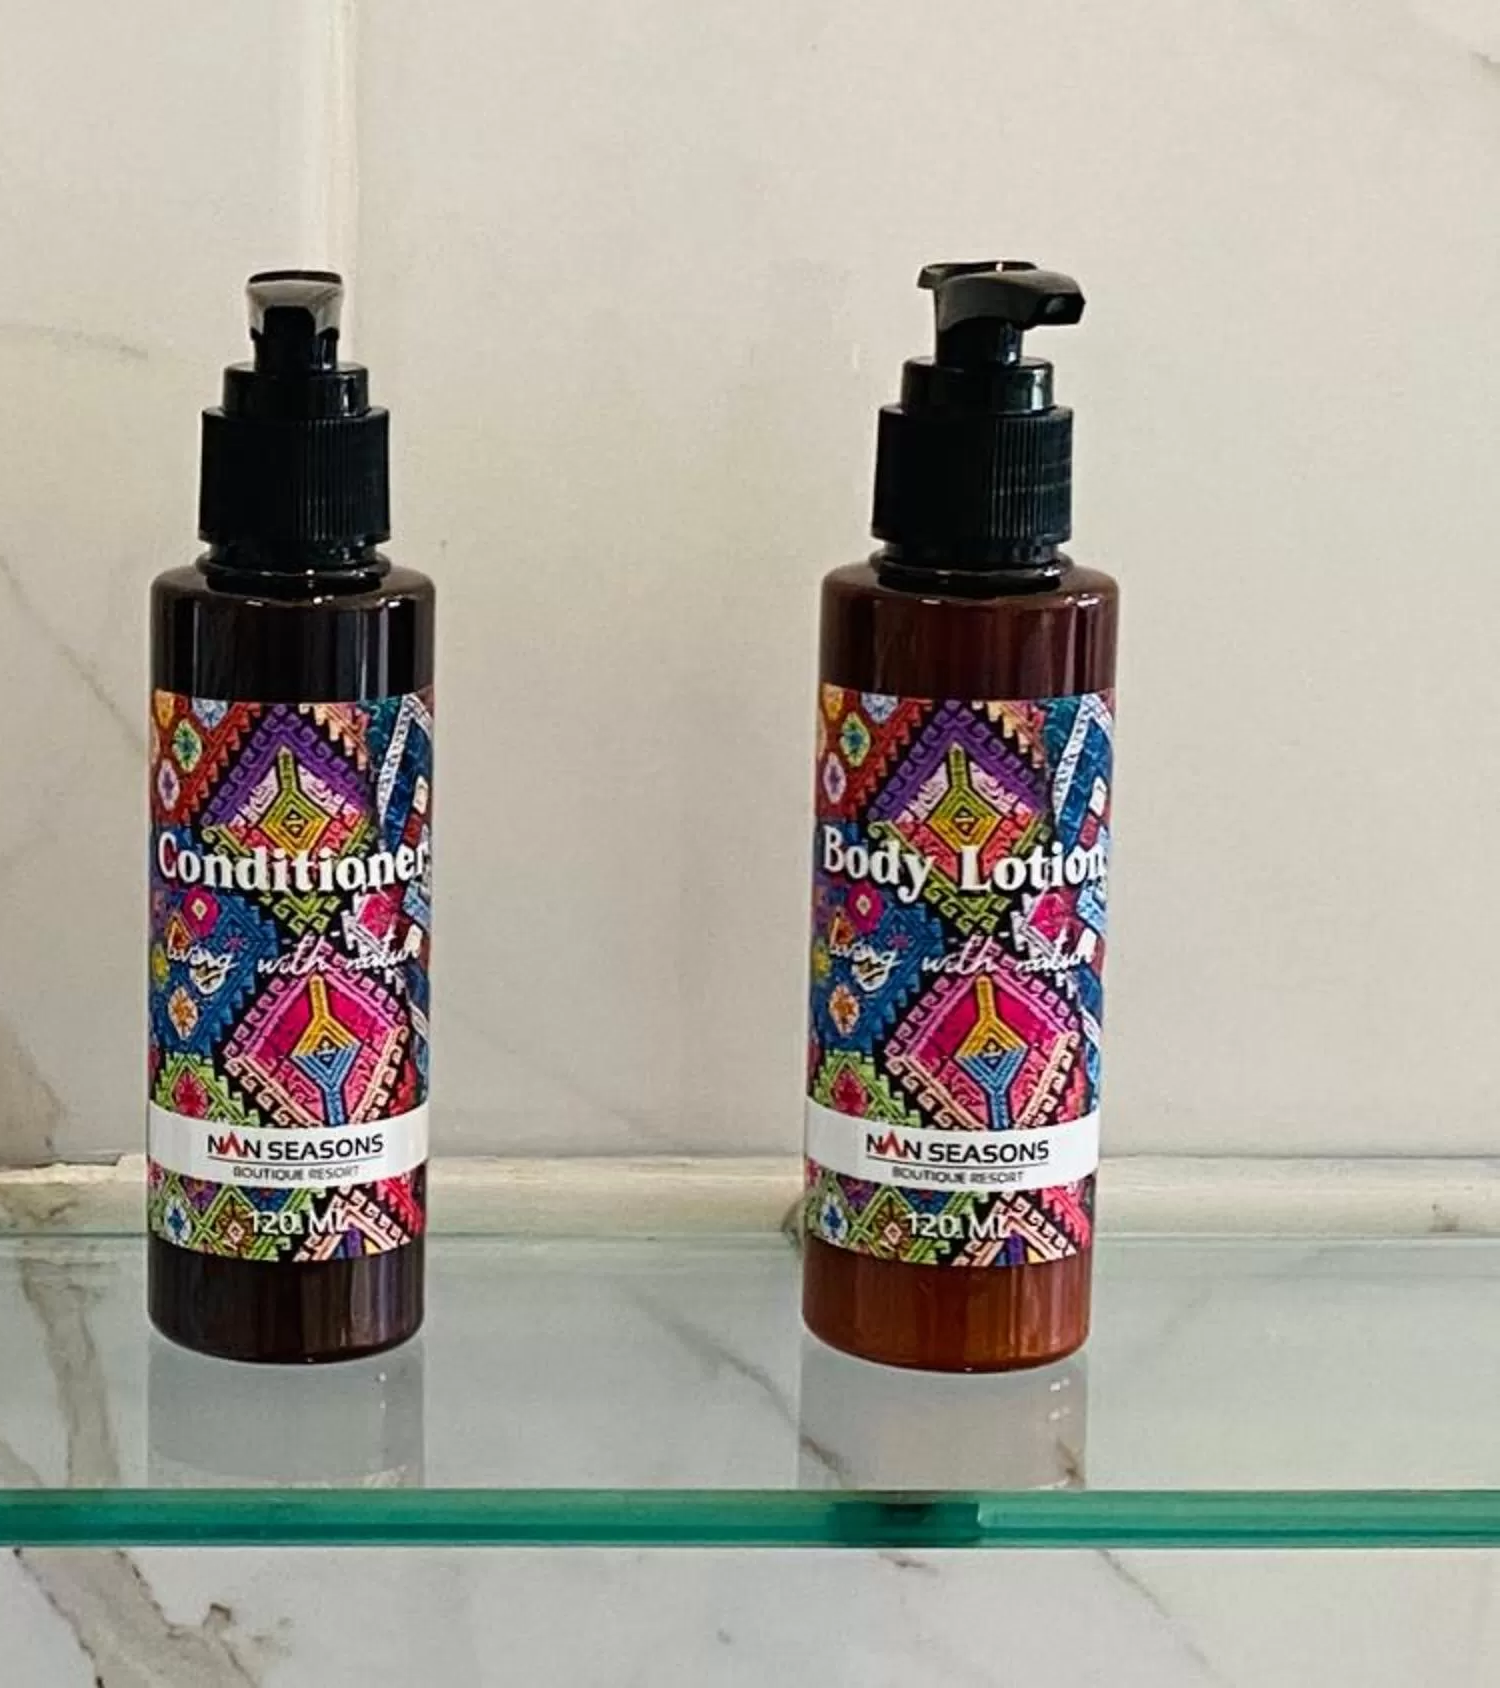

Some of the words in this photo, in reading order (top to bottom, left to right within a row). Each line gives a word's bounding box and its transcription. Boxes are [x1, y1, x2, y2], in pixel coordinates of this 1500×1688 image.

[158, 831, 429, 891] Conditioner
[822, 824, 936, 903] Body
[960, 841, 1108, 892] Lotion
[257, 931, 328, 977] with
[922, 931, 996, 975] with
[207, 1131, 261, 1160] NAN
[267, 1133, 384, 1160] SEASONS
[866, 1130, 921, 1160] NAN
[928, 1139, 1049, 1163] SEASONS
[233, 1165, 304, 1181] BOUTIQUE
[308, 1165, 358, 1180] RESORT
[892, 1167, 966, 1185] BOUTIQUE
[970, 1171, 1024, 1185] RESORT
[251, 1210, 295, 1235] 120
[910, 1213, 956, 1240] 120
